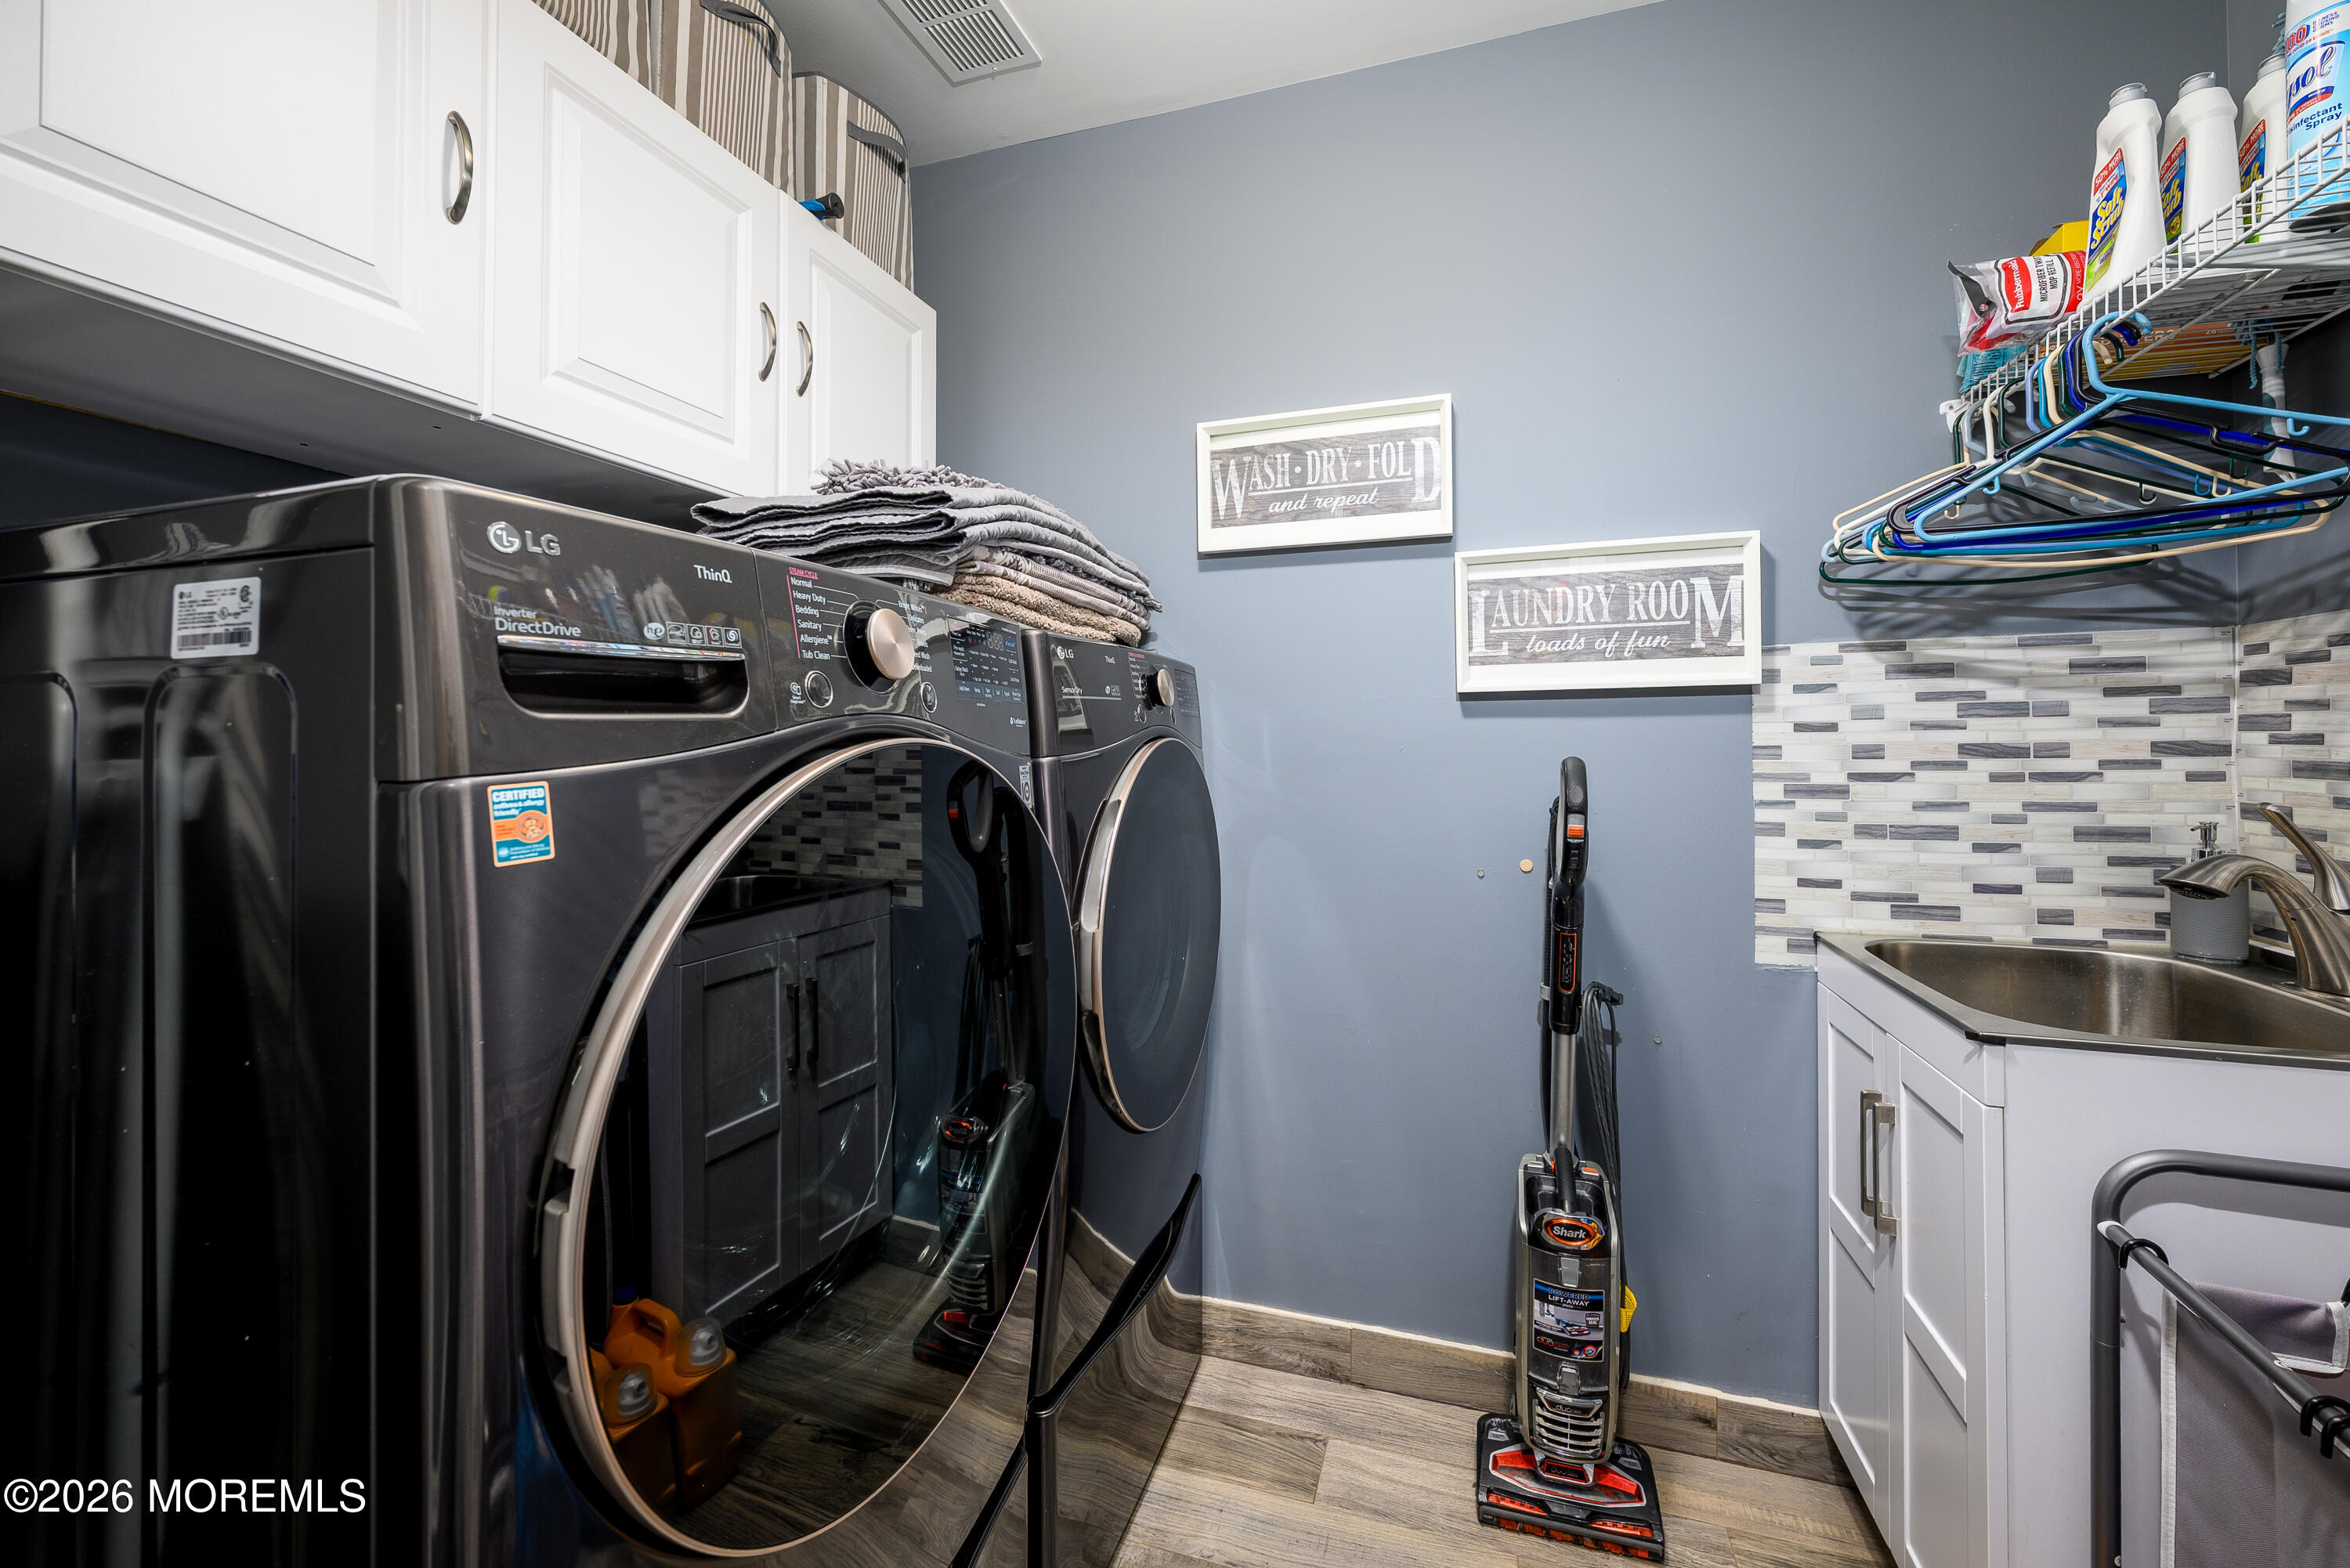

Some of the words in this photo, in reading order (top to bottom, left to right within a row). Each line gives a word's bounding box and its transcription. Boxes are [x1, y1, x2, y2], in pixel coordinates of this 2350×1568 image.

[2287, 45, 2334, 110] ysol
[2287, 103, 2342, 135] isinfectant
[2305, 111, 2342, 130] Spray
[2250, 122, 2264, 144] MORE
[2171, 139, 2185, 161] MORE
[2095, 167, 2109, 188] 50%
[2109, 149, 2122, 171] MORE
[2096, 186, 2123, 226] Soft
[2091, 196, 2124, 249] Scrub
[2046, 259, 2057, 276] REFILL
[2008, 259, 2025, 309] Rubbermaid
[2037, 269, 2048, 302] MICROFIBER
[2049, 276, 2058, 290] MOP
[1212, 453, 1291, 520] WASH
[1306, 446, 1352, 486] DRY
[1367, 436, 1441, 503] FOLD
[1268, 493, 1308, 514] and
[1313, 487, 1379, 513] repeat
[524, 529, 561, 556] LG
[693, 564, 732, 584] ThinQ
[789, 566, 804, 576] STEAM
[804, 570, 819, 579] CYCLE
[790, 576, 813, 588] Normal
[792, 590, 812, 602] Heavy
[812, 593, 826, 605] Duty
[494, 605, 537, 619] Inverter
[795, 604, 819, 617] Bedding
[1468, 583, 1616, 657] LAUNDRY
[1626, 574, 1745, 649] ROOM
[797, 619, 822, 631] Sanitary
[1526, 632, 1585, 653] loads
[1594, 630, 1619, 657] of
[1622, 630, 1672, 657] fun
[801, 649, 813, 659] Tub
[814, 650, 830, 660] Clean
[1065, 648, 1074, 659] LG
[492, 787, 545, 803] CERTIFIED
[1553, 1226, 1586, 1239] Shark
[1548, 1287, 1590, 1301] POWERED
[1548, 1294, 1590, 1306] LIFT-AWAY
